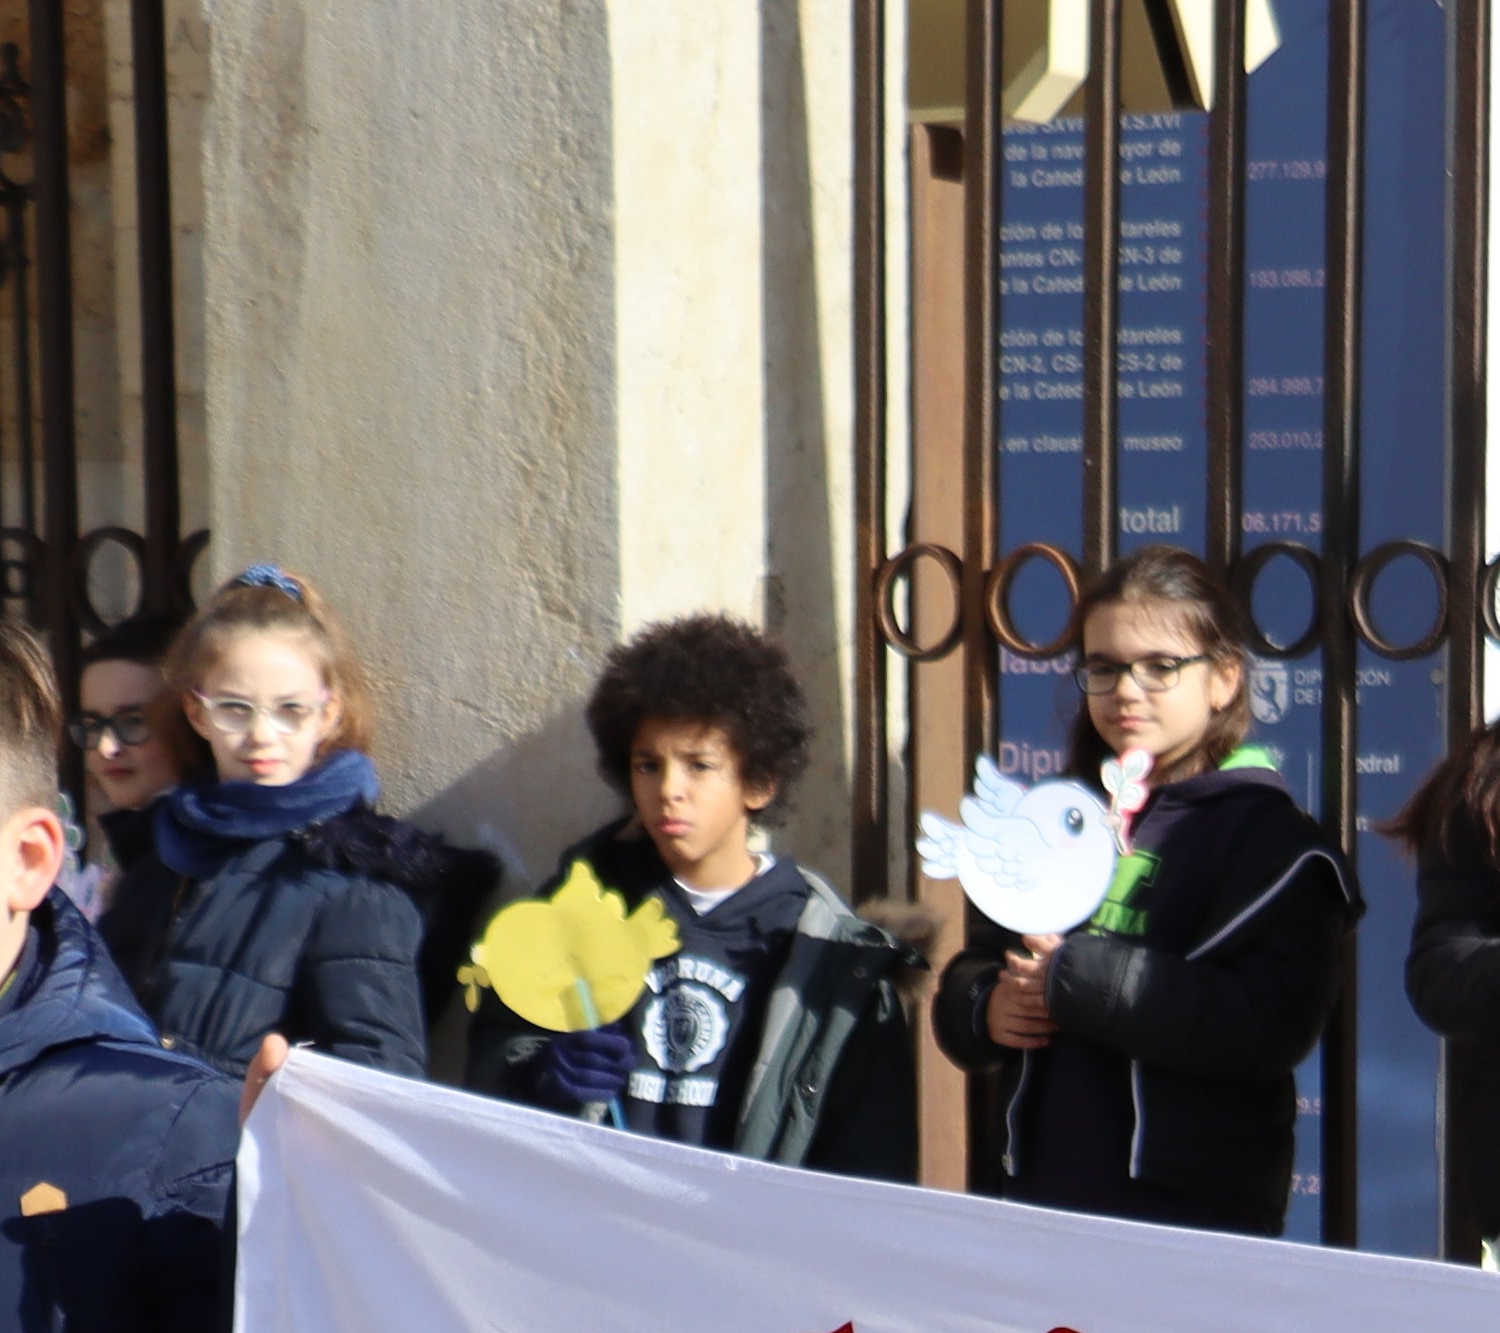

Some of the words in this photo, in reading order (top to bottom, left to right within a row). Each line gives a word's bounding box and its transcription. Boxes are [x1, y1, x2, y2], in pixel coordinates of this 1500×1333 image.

[1051, 144, 1084, 160] nav
[1158, 139, 1182, 156] de
[1031, 168, 1084, 188] Cated
[1120, 170, 1133, 185] e
[1137, 166, 1182, 184] León
[1068, 222, 1084, 240] lo
[1159, 246, 1182, 263] de
[1032, 274, 1084, 294] Cated
[1137, 271, 1182, 290] León
[1051, 354, 1083, 373] CS-
[1159, 353, 1183, 371] de
[1138, 378, 1183, 397] León
[1122, 435, 1183, 452] museo
[1118, 504, 1181, 534] total
